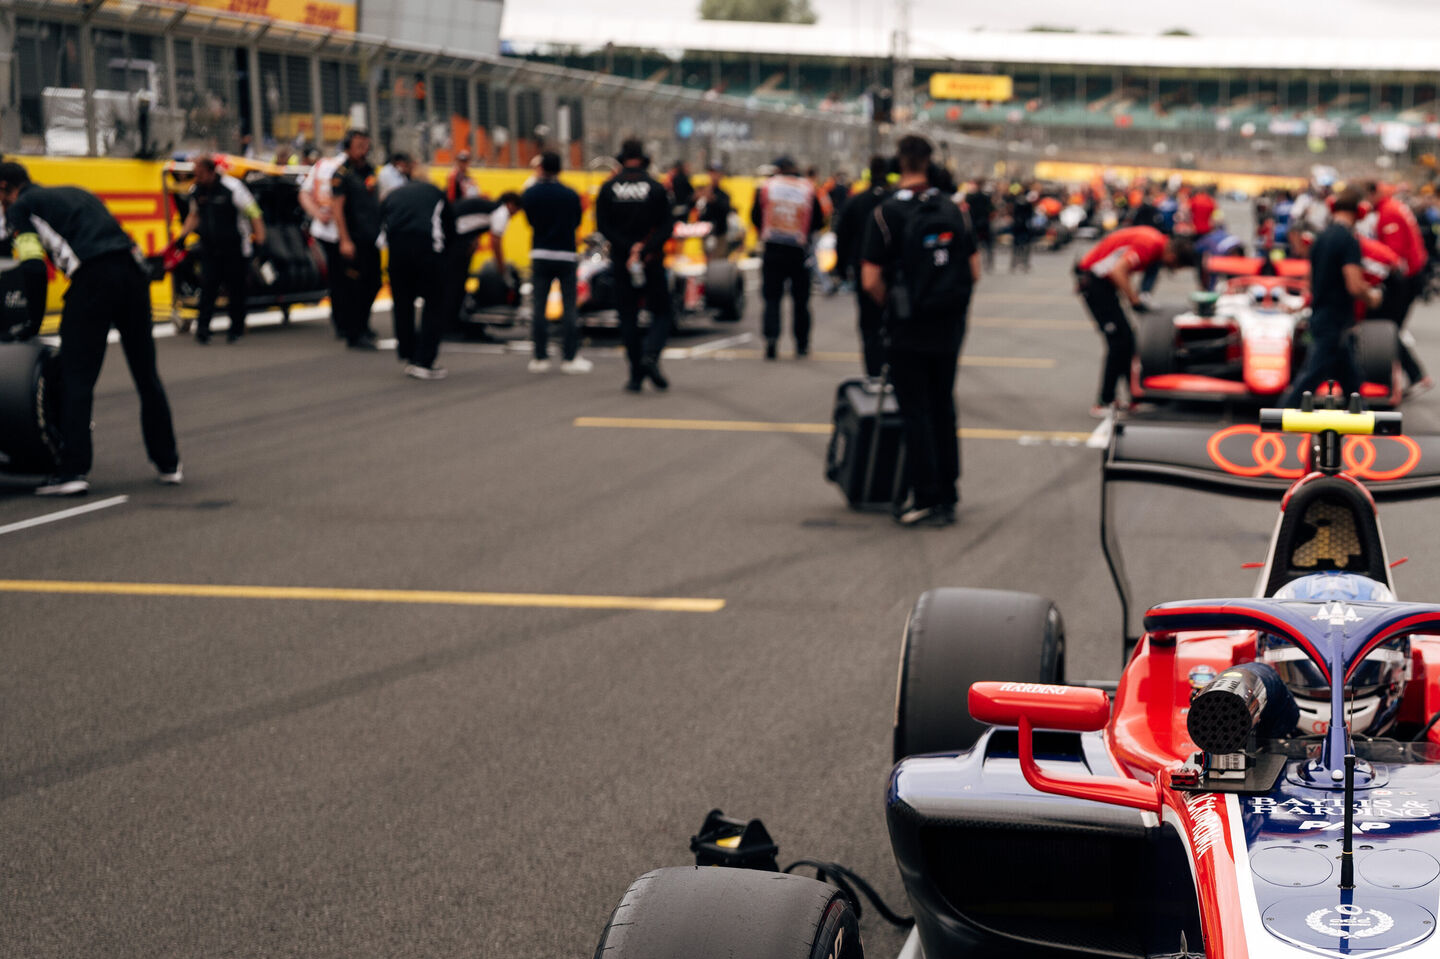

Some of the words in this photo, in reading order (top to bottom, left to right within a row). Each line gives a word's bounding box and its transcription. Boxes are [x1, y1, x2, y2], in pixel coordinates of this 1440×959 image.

[1402, 799, 1430, 809] &
[1252, 805, 1432, 817] HARDING
[1298, 820, 1391, 834] PAP
